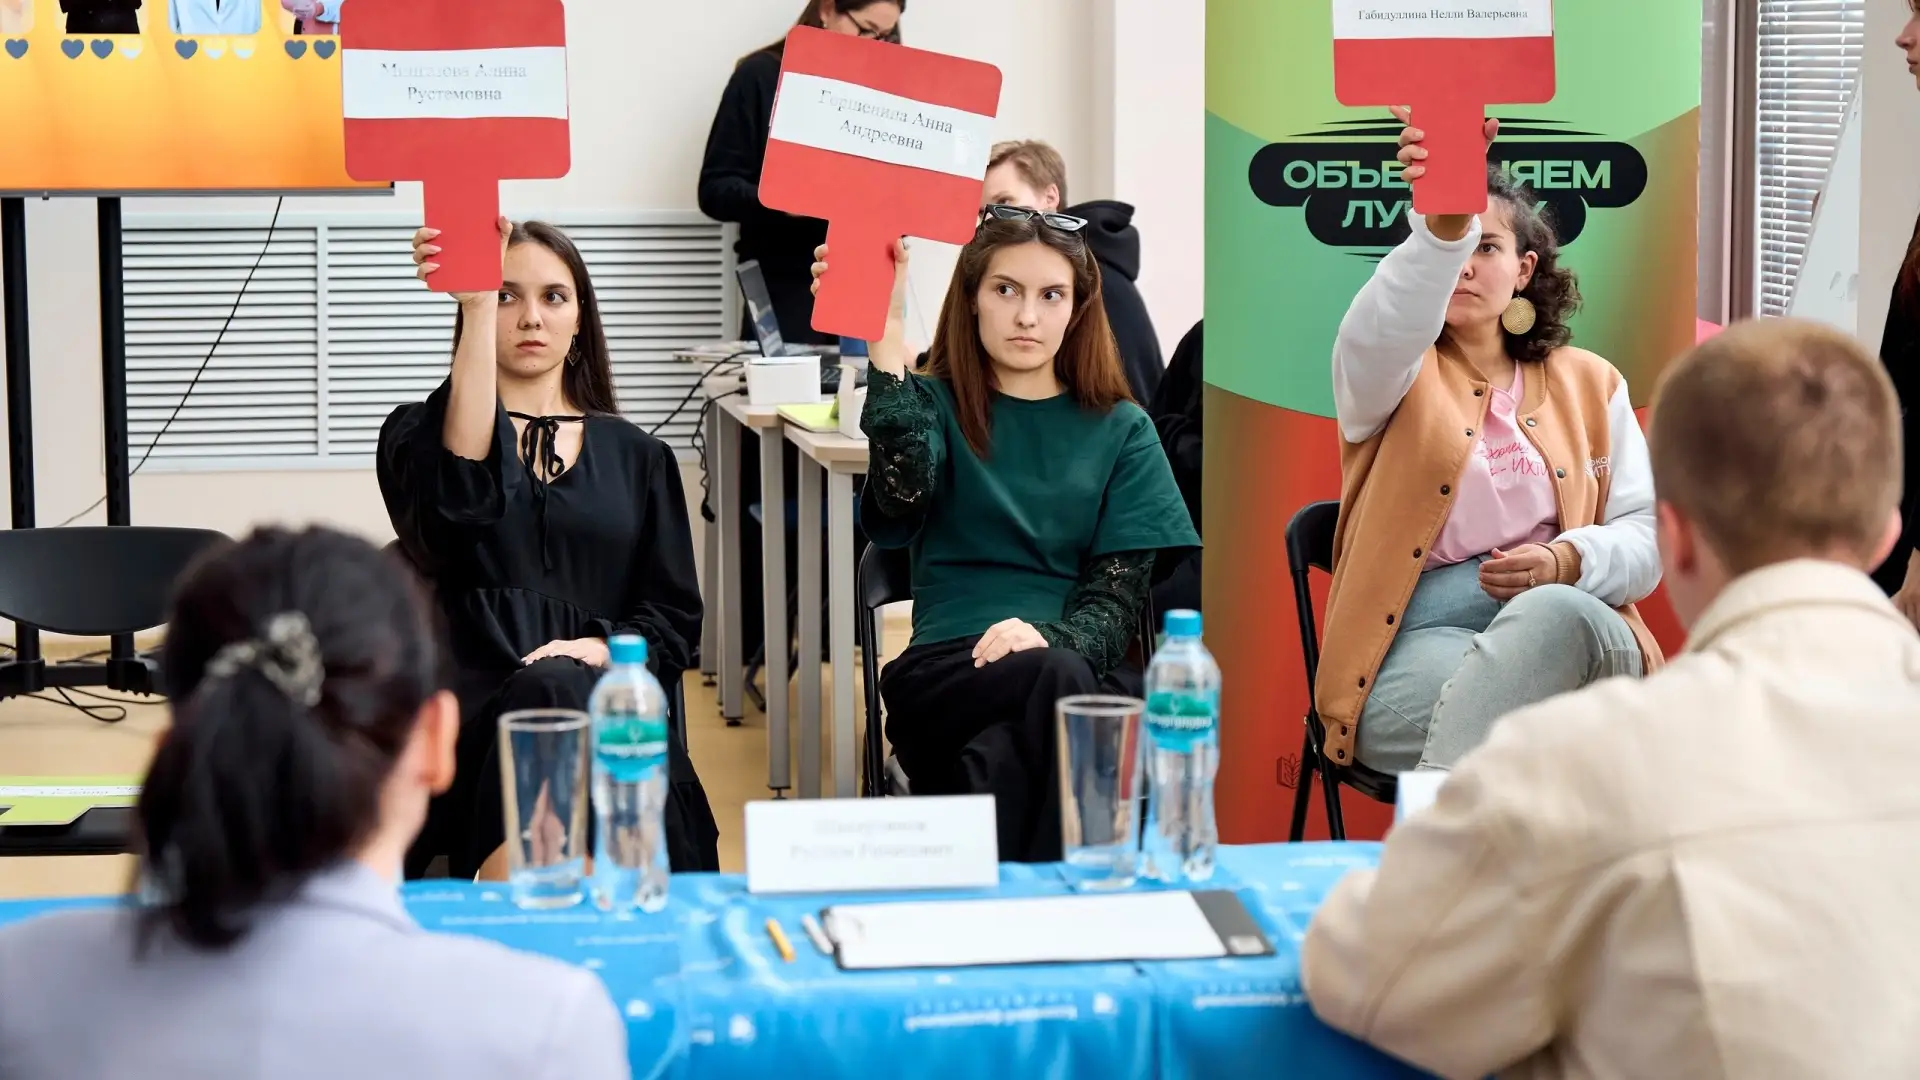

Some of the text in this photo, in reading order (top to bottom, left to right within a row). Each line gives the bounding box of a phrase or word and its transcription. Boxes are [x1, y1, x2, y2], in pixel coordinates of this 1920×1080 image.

[1358, 9, 1528, 21] Габидуллина Нелли Валерьевна
[475, 63, 528, 78] Алина
[407, 86, 503, 104] Рустемовна
[912, 112, 953, 134] Анна
[840, 119, 923, 150] Андреевна
[1283, 160, 1611, 191] ОБЪЕЯЕМ
